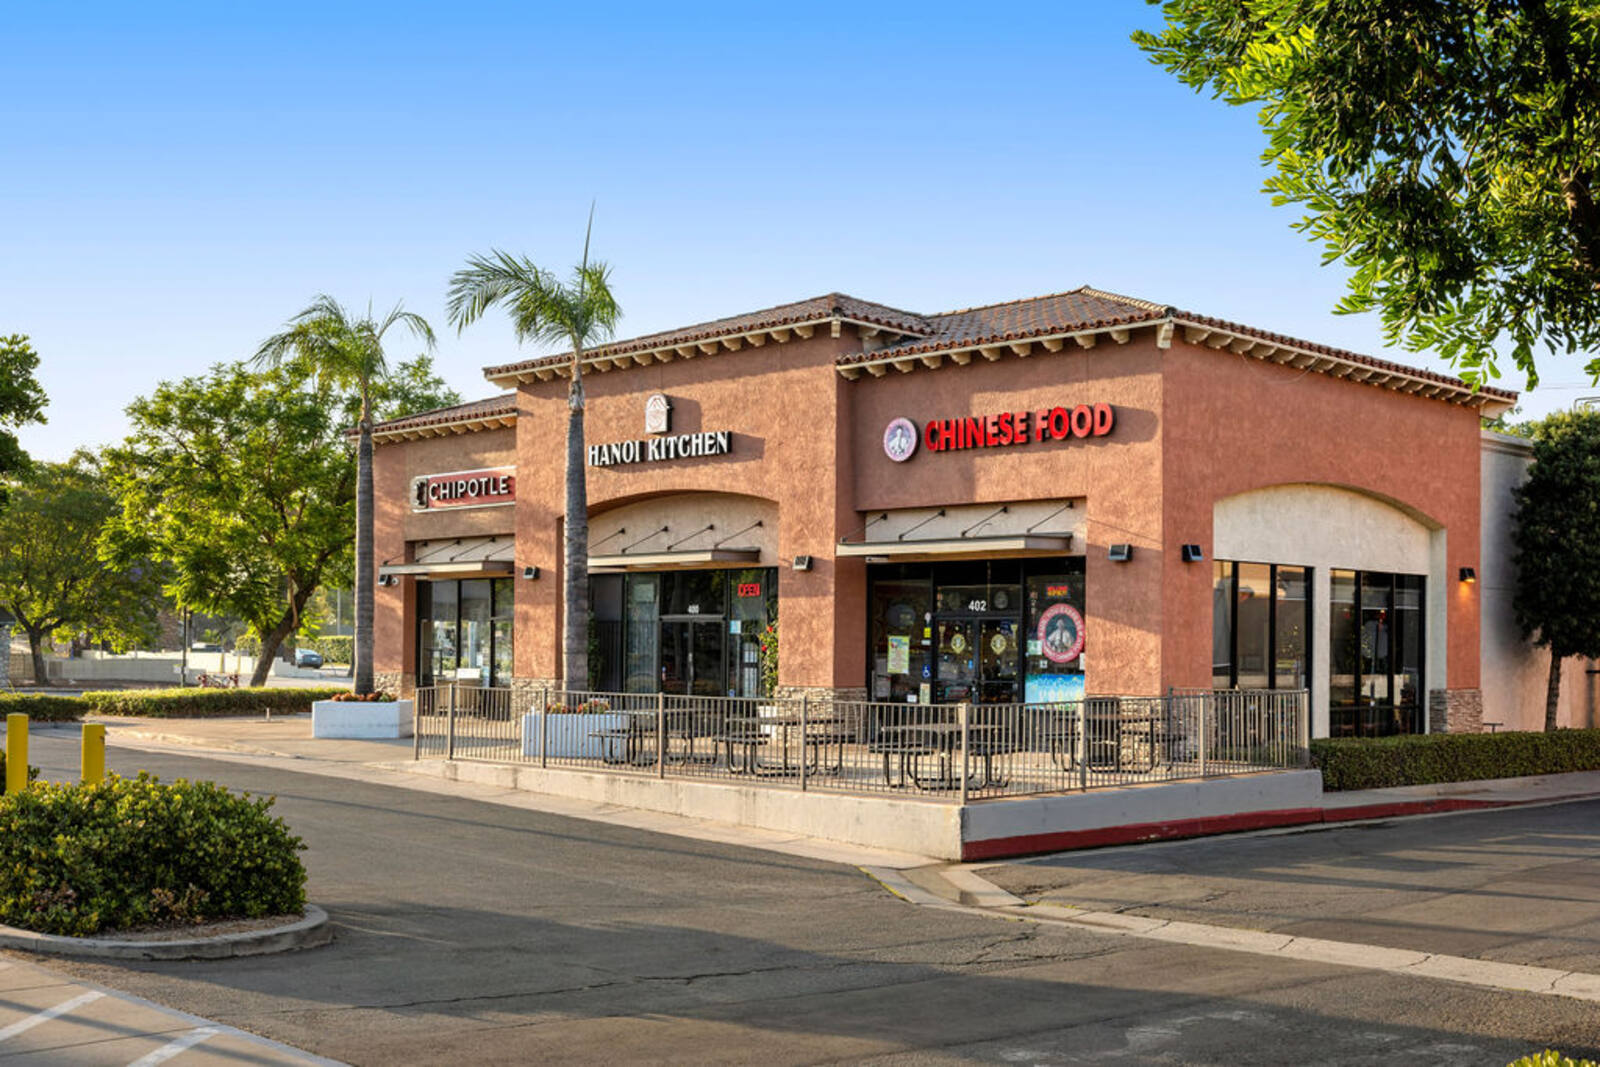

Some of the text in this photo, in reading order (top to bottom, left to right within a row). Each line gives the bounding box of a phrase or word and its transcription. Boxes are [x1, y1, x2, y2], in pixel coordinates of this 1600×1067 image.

[924, 402, 1114, 451] CHINESE FOOD
[588, 430, 730, 466] HANOI KITCHEN
[429, 476, 509, 501] CHIPOTLE
[737, 583, 760, 597] OPEN
[968, 599, 987, 612] 402
